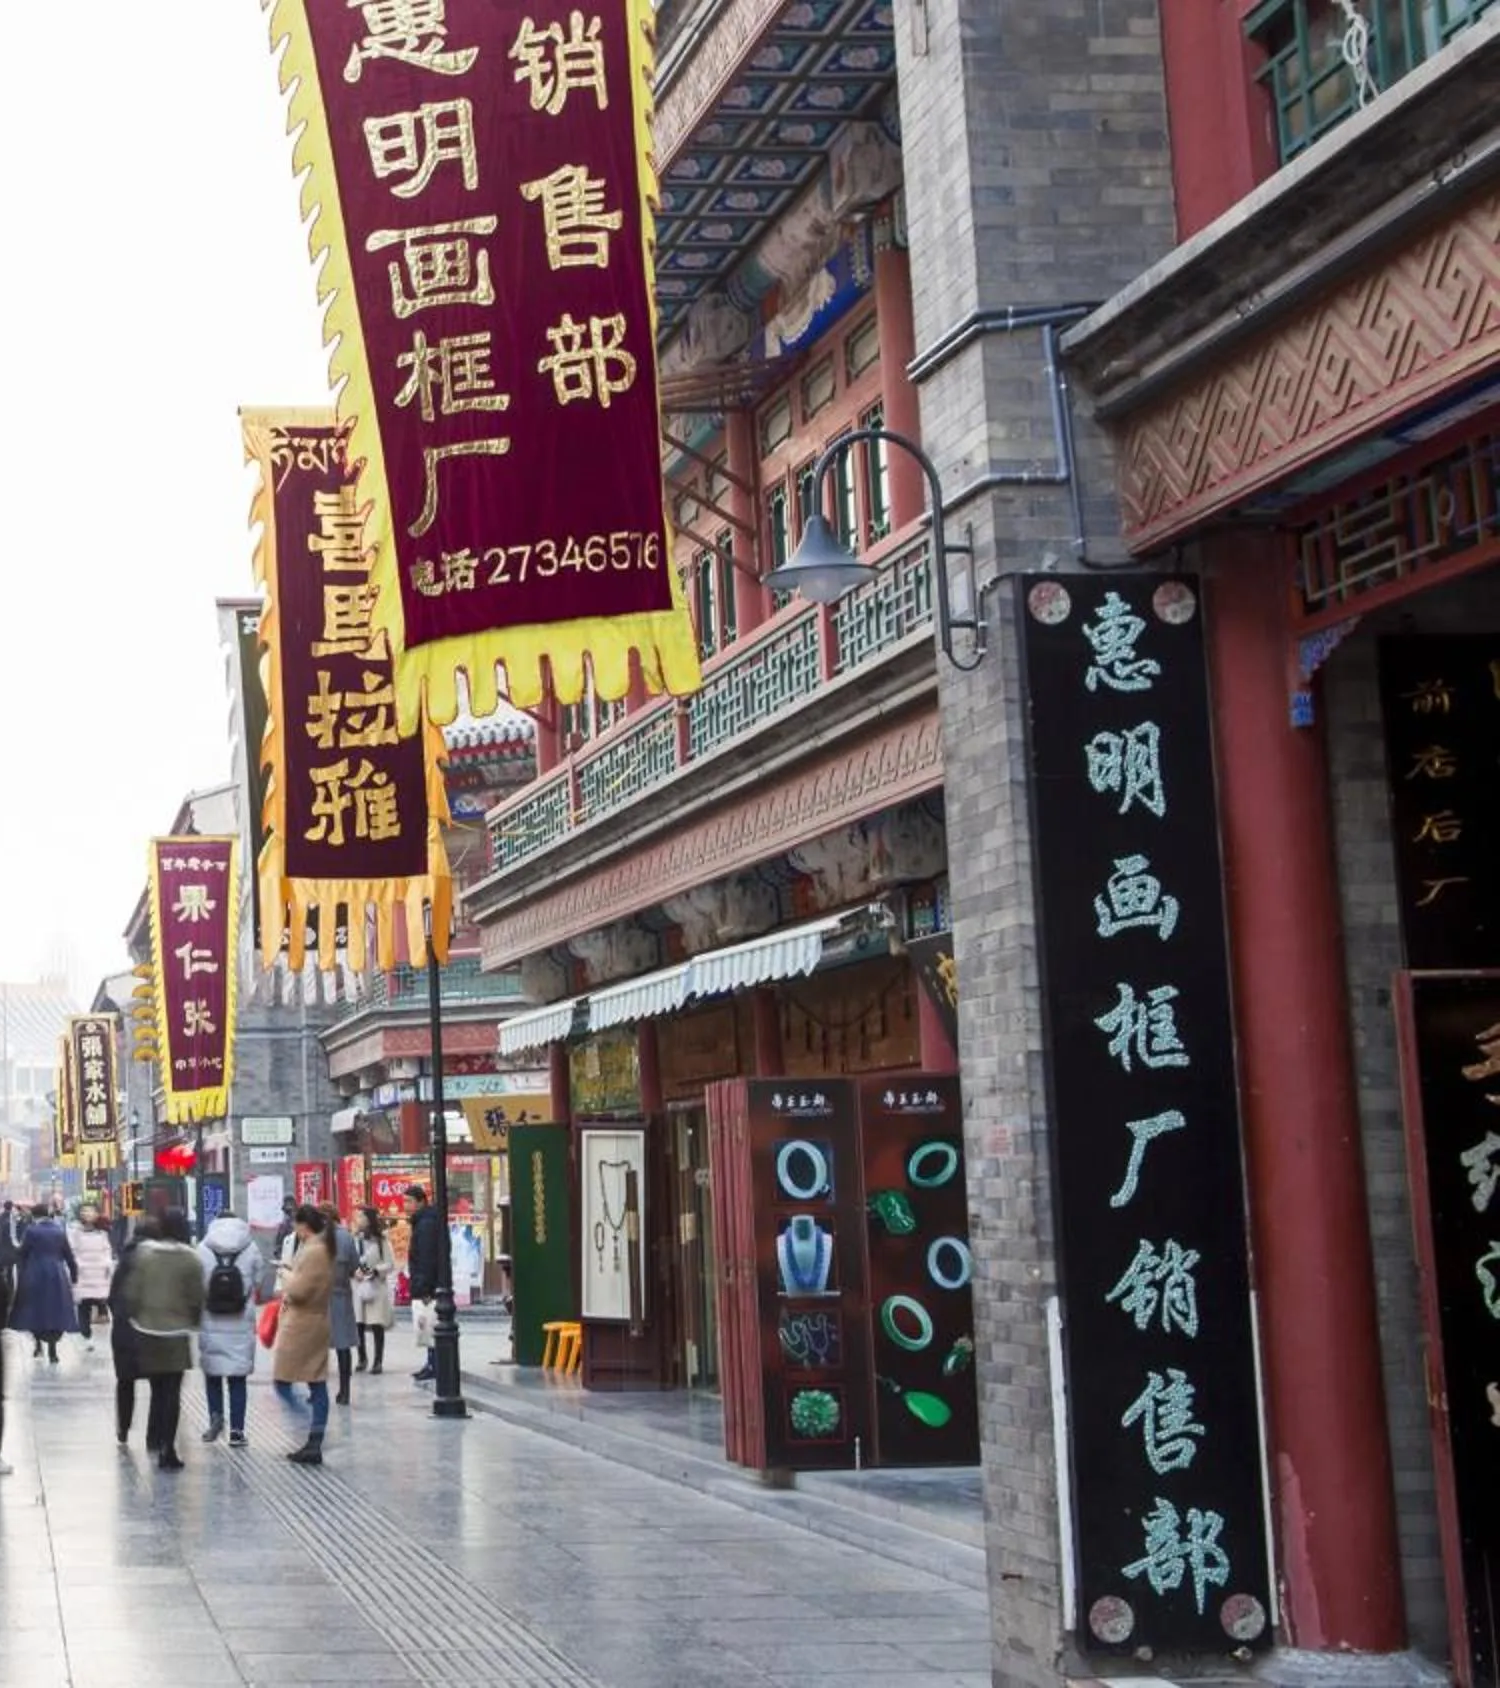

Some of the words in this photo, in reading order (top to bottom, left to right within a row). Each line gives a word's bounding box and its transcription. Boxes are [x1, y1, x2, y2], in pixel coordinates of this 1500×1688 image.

[508, 10, 636, 408] 销售部
[1406, 679, 1470, 907] 前店后厂
[172, 884, 218, 1037] 果仁张
